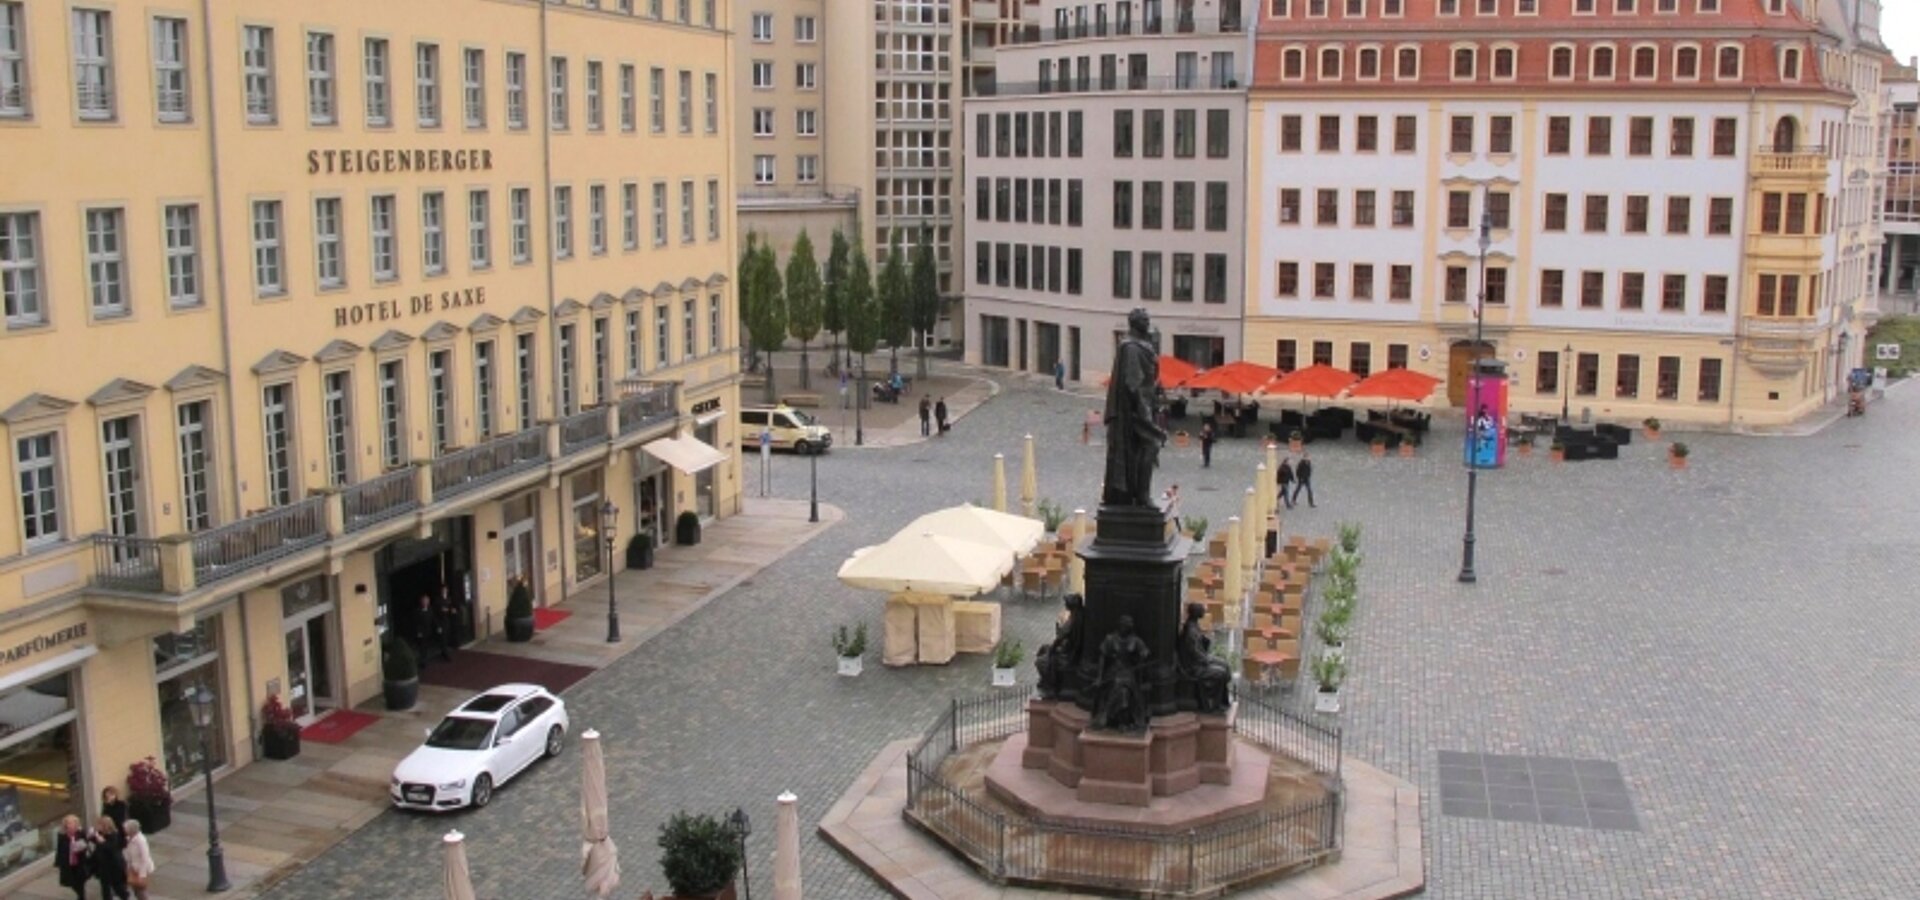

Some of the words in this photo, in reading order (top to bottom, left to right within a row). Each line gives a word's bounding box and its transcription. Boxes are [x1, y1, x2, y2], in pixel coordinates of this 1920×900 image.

[307, 149, 492, 174] STEIGENBERGER
[334, 300, 401, 328] HOTEL
[410, 293, 433, 316] DE
[441, 286, 485, 310] SAXE
